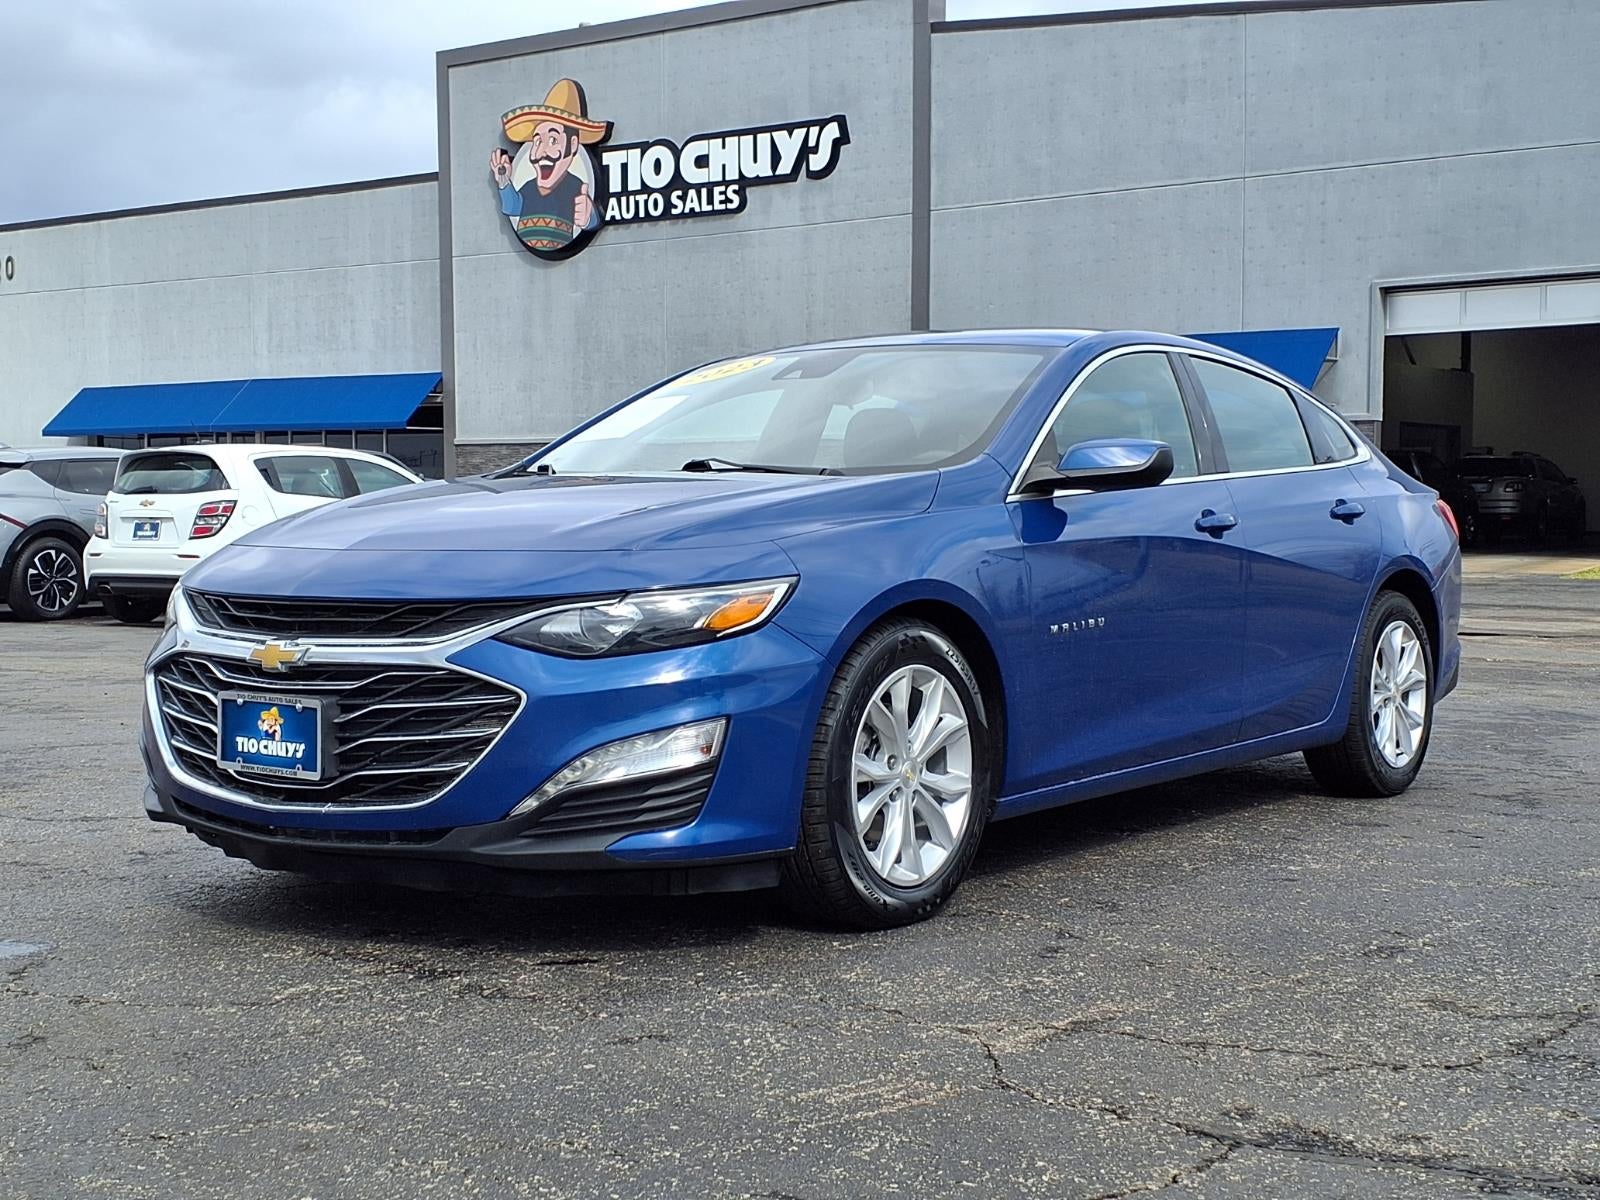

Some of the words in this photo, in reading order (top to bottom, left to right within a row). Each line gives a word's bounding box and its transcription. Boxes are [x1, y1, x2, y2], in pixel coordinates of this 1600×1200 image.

[602, 145, 675, 193] TIO
[679, 122, 840, 184] CHUY'S
[605, 193, 664, 221] AUTO
[670, 184, 740, 215] SALES
[1050, 617, 1105, 634] MALIBU
[235, 736, 258, 753] TIO
[259, 739, 305, 759] CHUY'S
